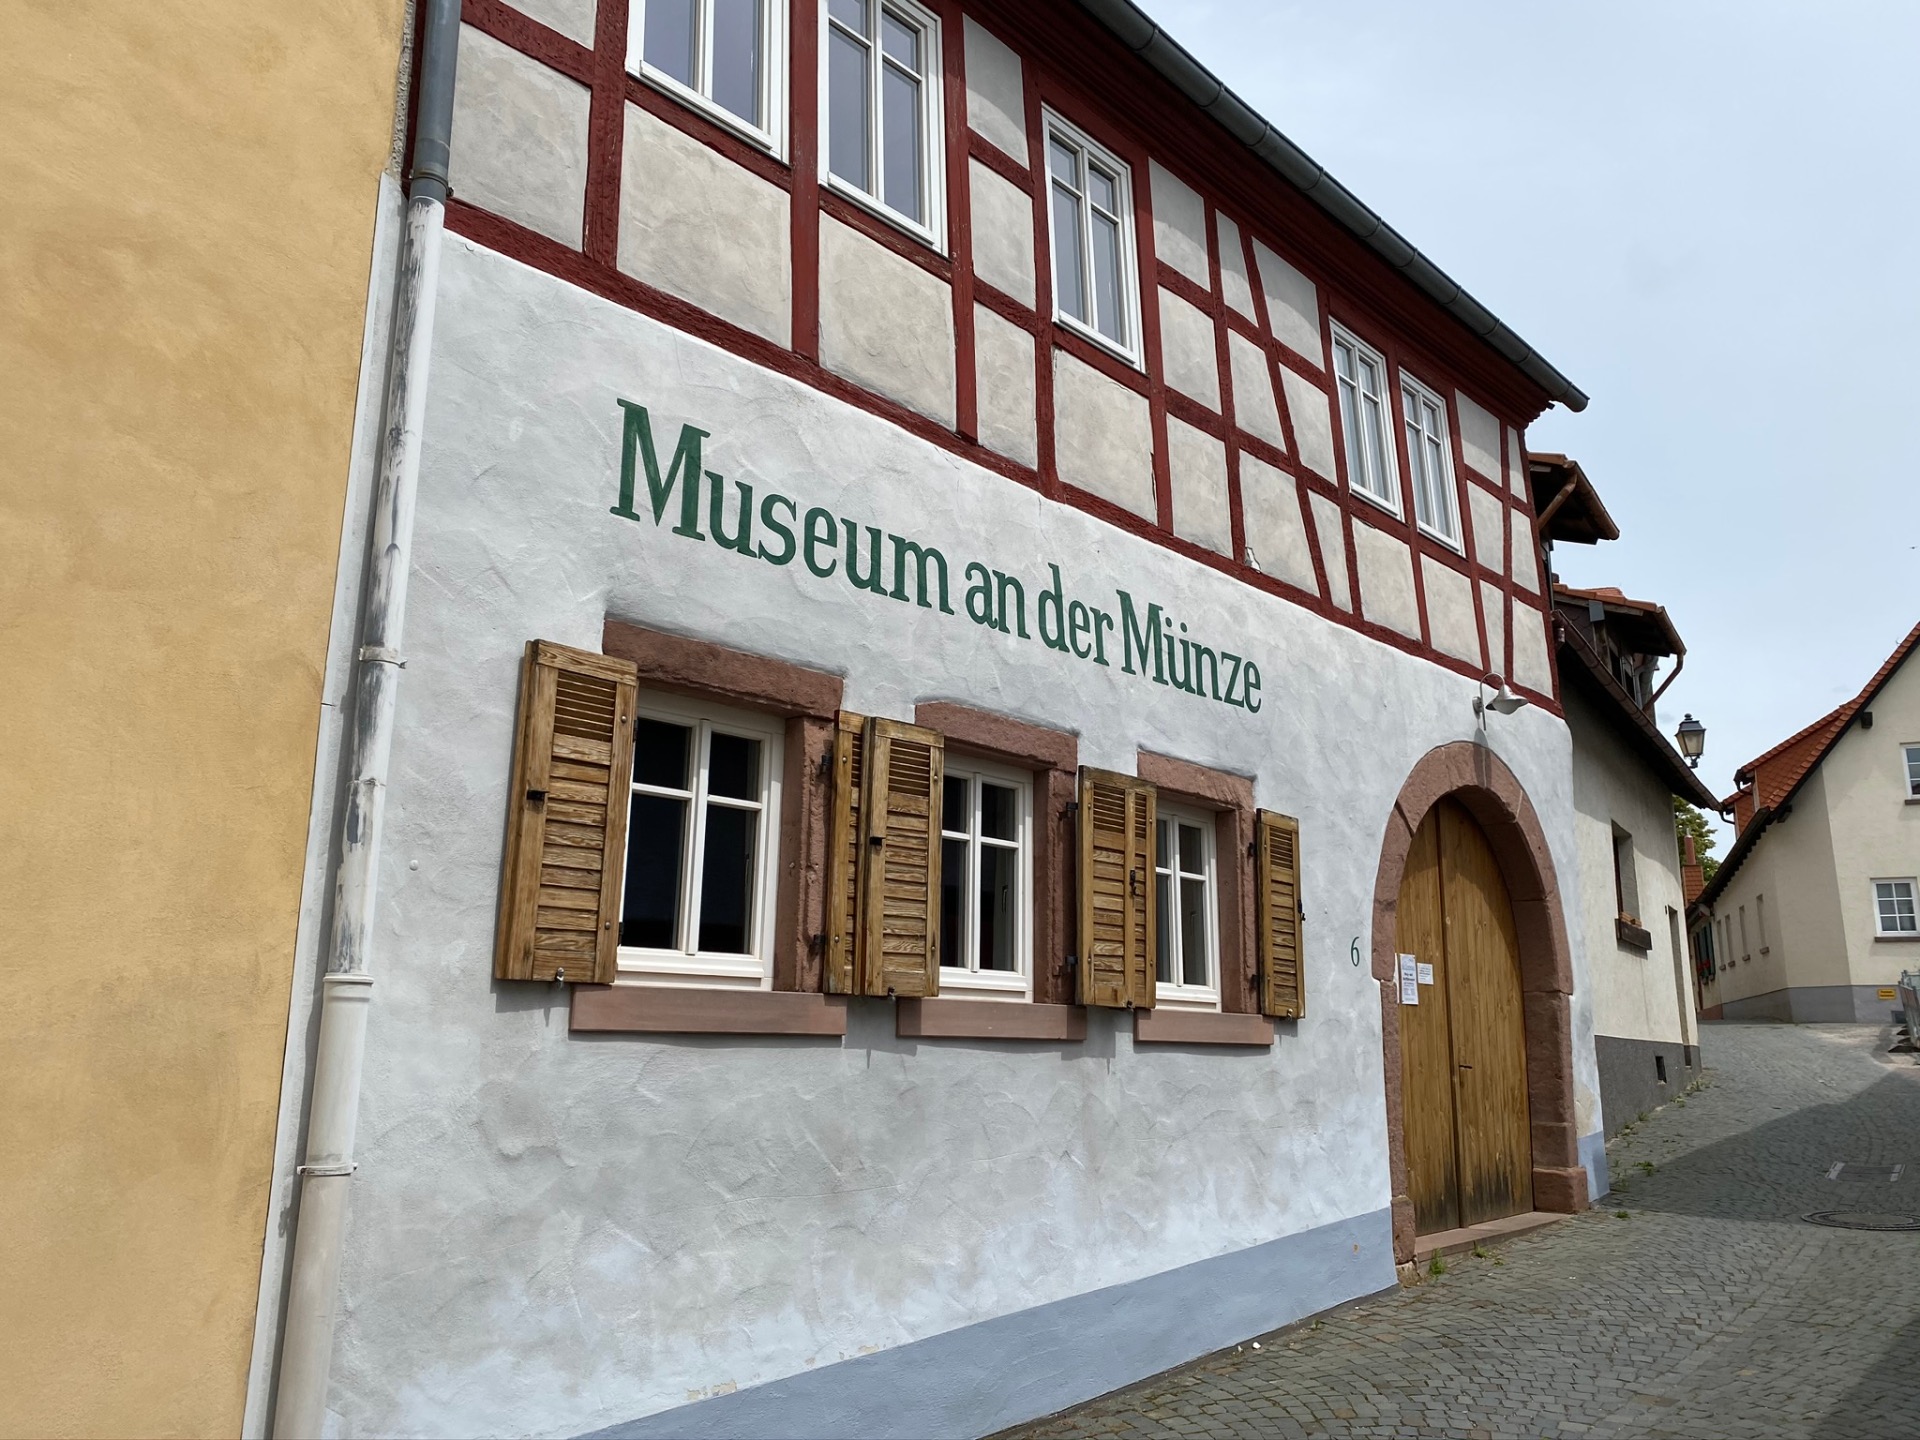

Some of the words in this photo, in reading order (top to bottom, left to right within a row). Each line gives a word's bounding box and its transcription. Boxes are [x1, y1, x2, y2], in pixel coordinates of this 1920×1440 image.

[610, 397, 955, 616] Museum
[965, 561, 1031, 640] an
[1038, 562, 1114, 667] der
[1115, 588, 1262, 714] Münze
[1350, 936, 1360, 968] 6
